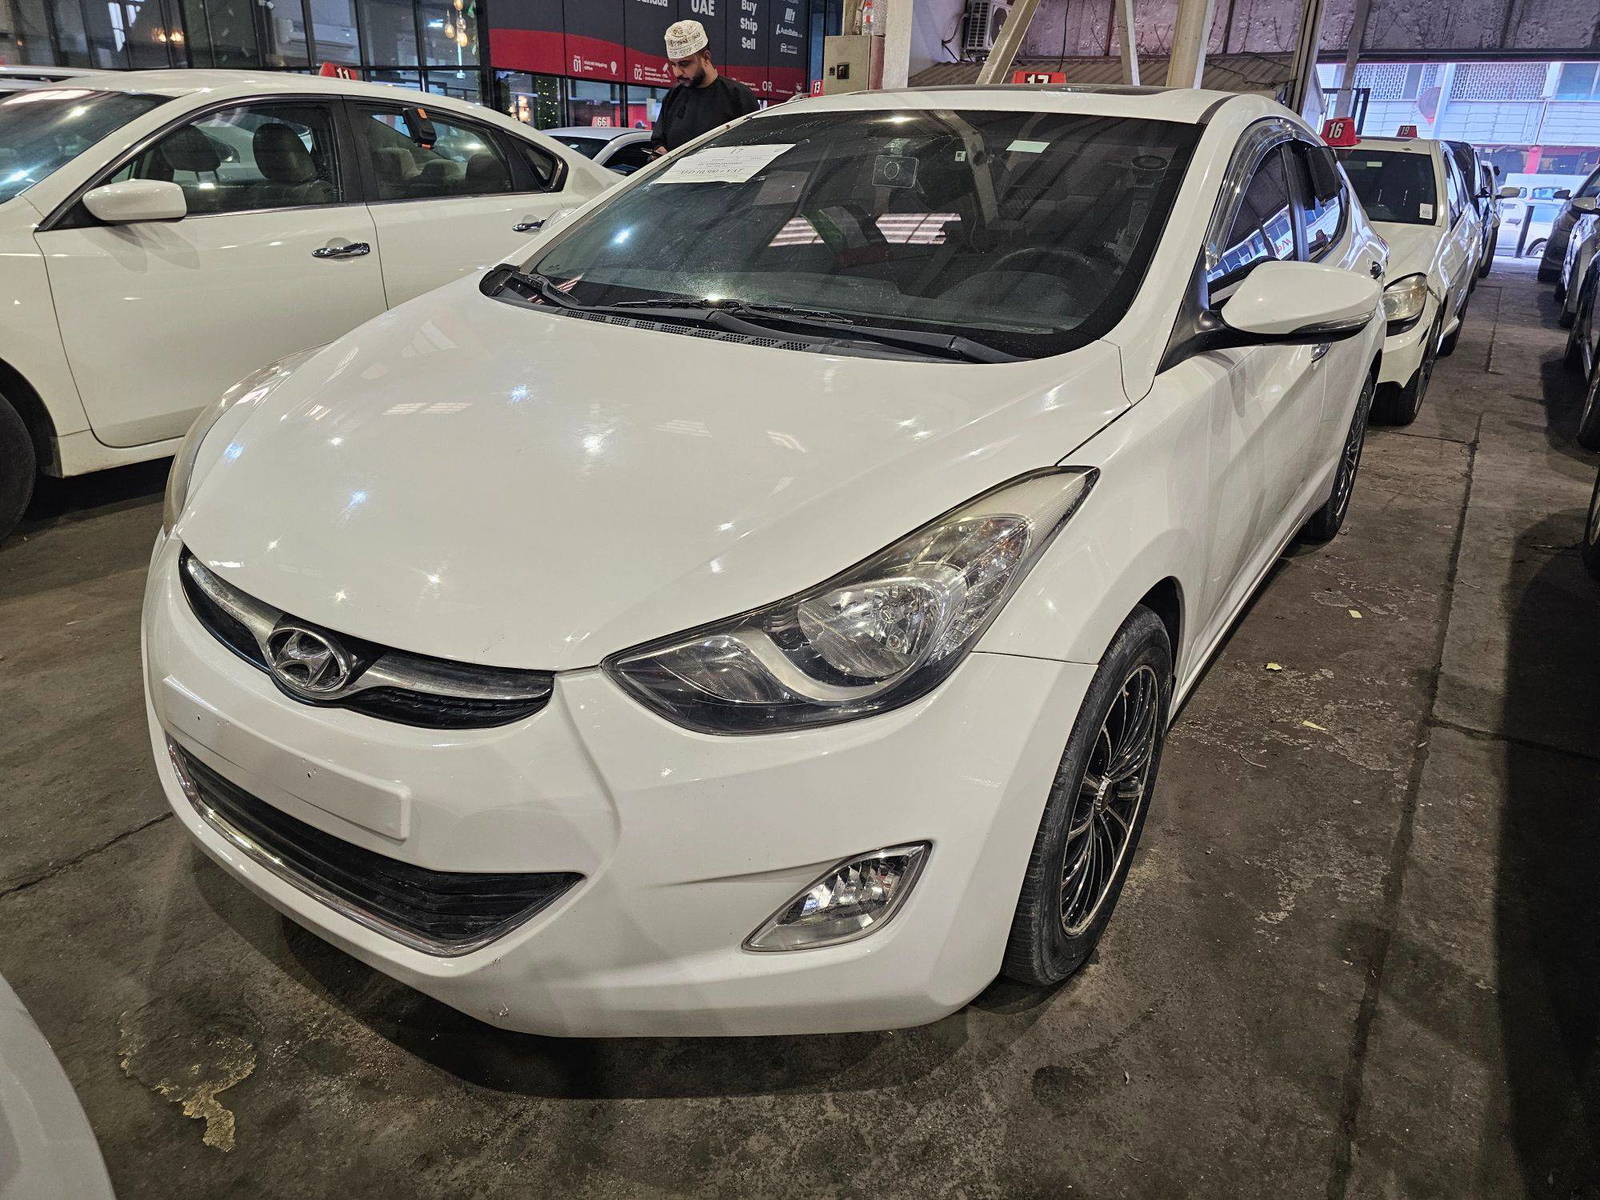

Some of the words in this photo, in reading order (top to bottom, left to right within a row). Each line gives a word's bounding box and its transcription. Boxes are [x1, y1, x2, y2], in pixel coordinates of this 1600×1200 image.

[691, 0, 715, 17] UAE
[741, 0, 757, 16] Buy
[740, 17, 758, 35] Ship
[741, 36, 756, 50] Sell
[573, 58, 582, 73] 01
[762, 80, 773, 92] OR
[1027, 73, 1049, 84] 17
[1327, 122, 1344, 139] 16
